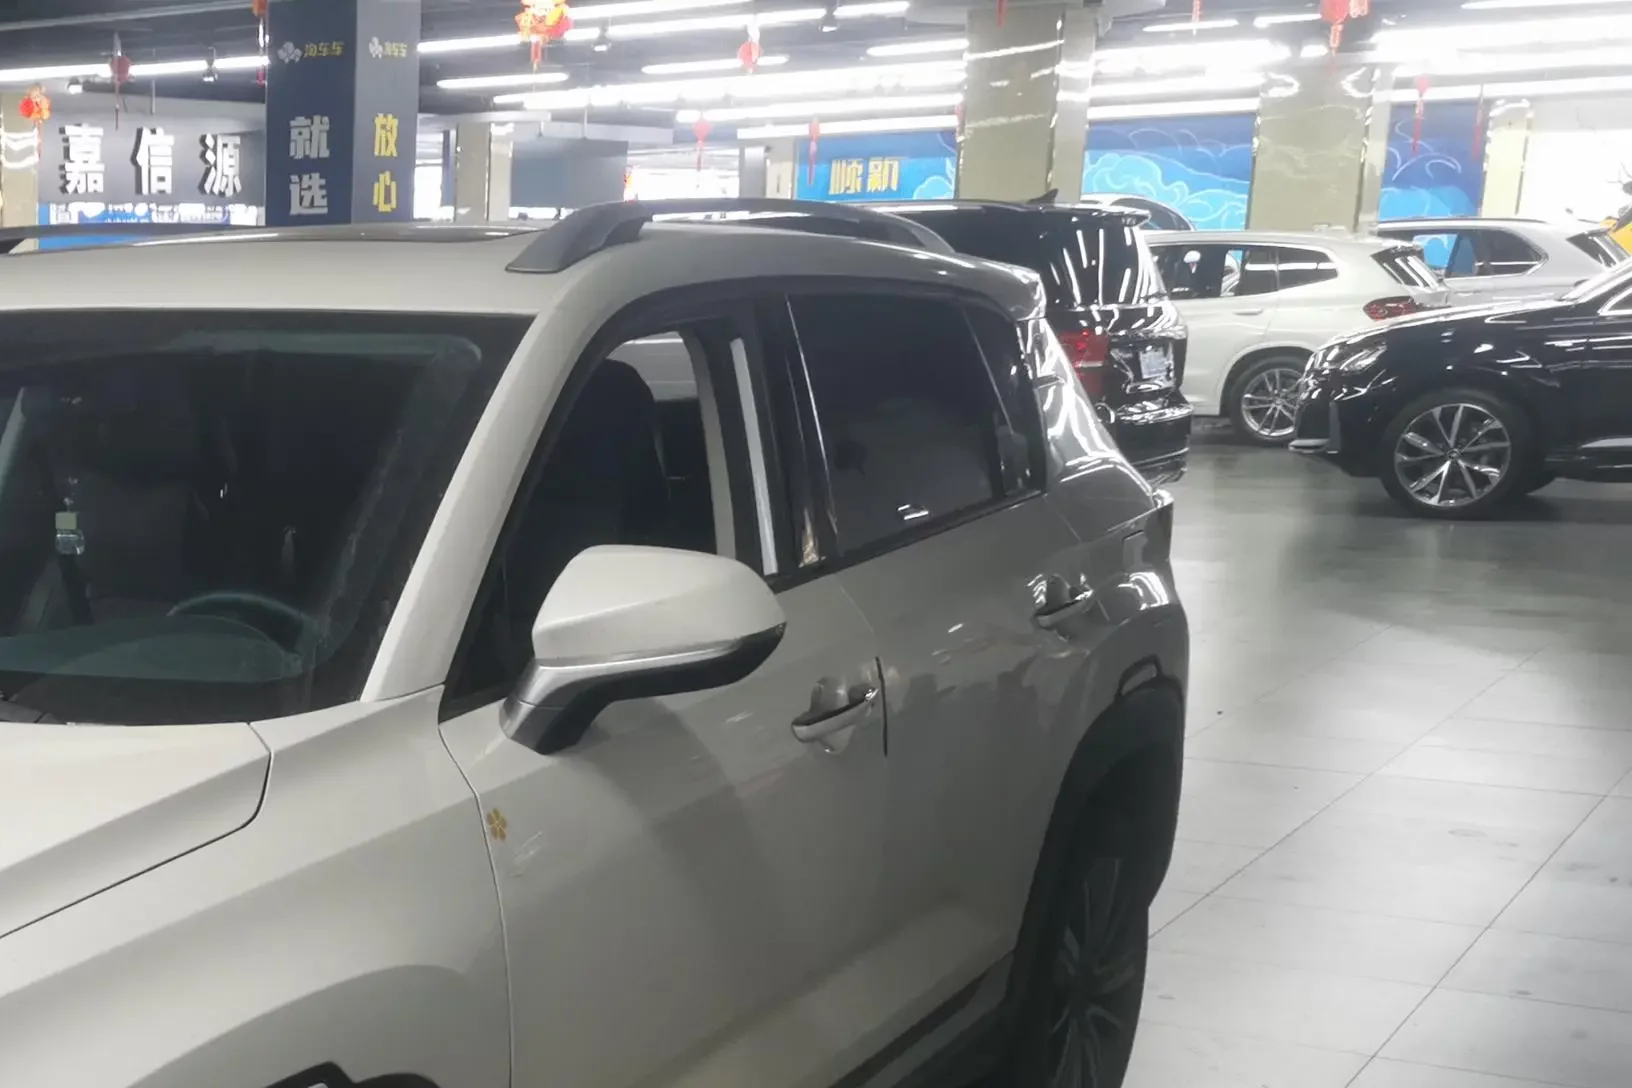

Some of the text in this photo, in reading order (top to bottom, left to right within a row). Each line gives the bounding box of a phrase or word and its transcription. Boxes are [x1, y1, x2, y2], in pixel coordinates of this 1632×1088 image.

[62, 123, 242, 197] 嘉信源
[289, 114, 330, 215] 就选
[373, 113, 399, 212] 放心
